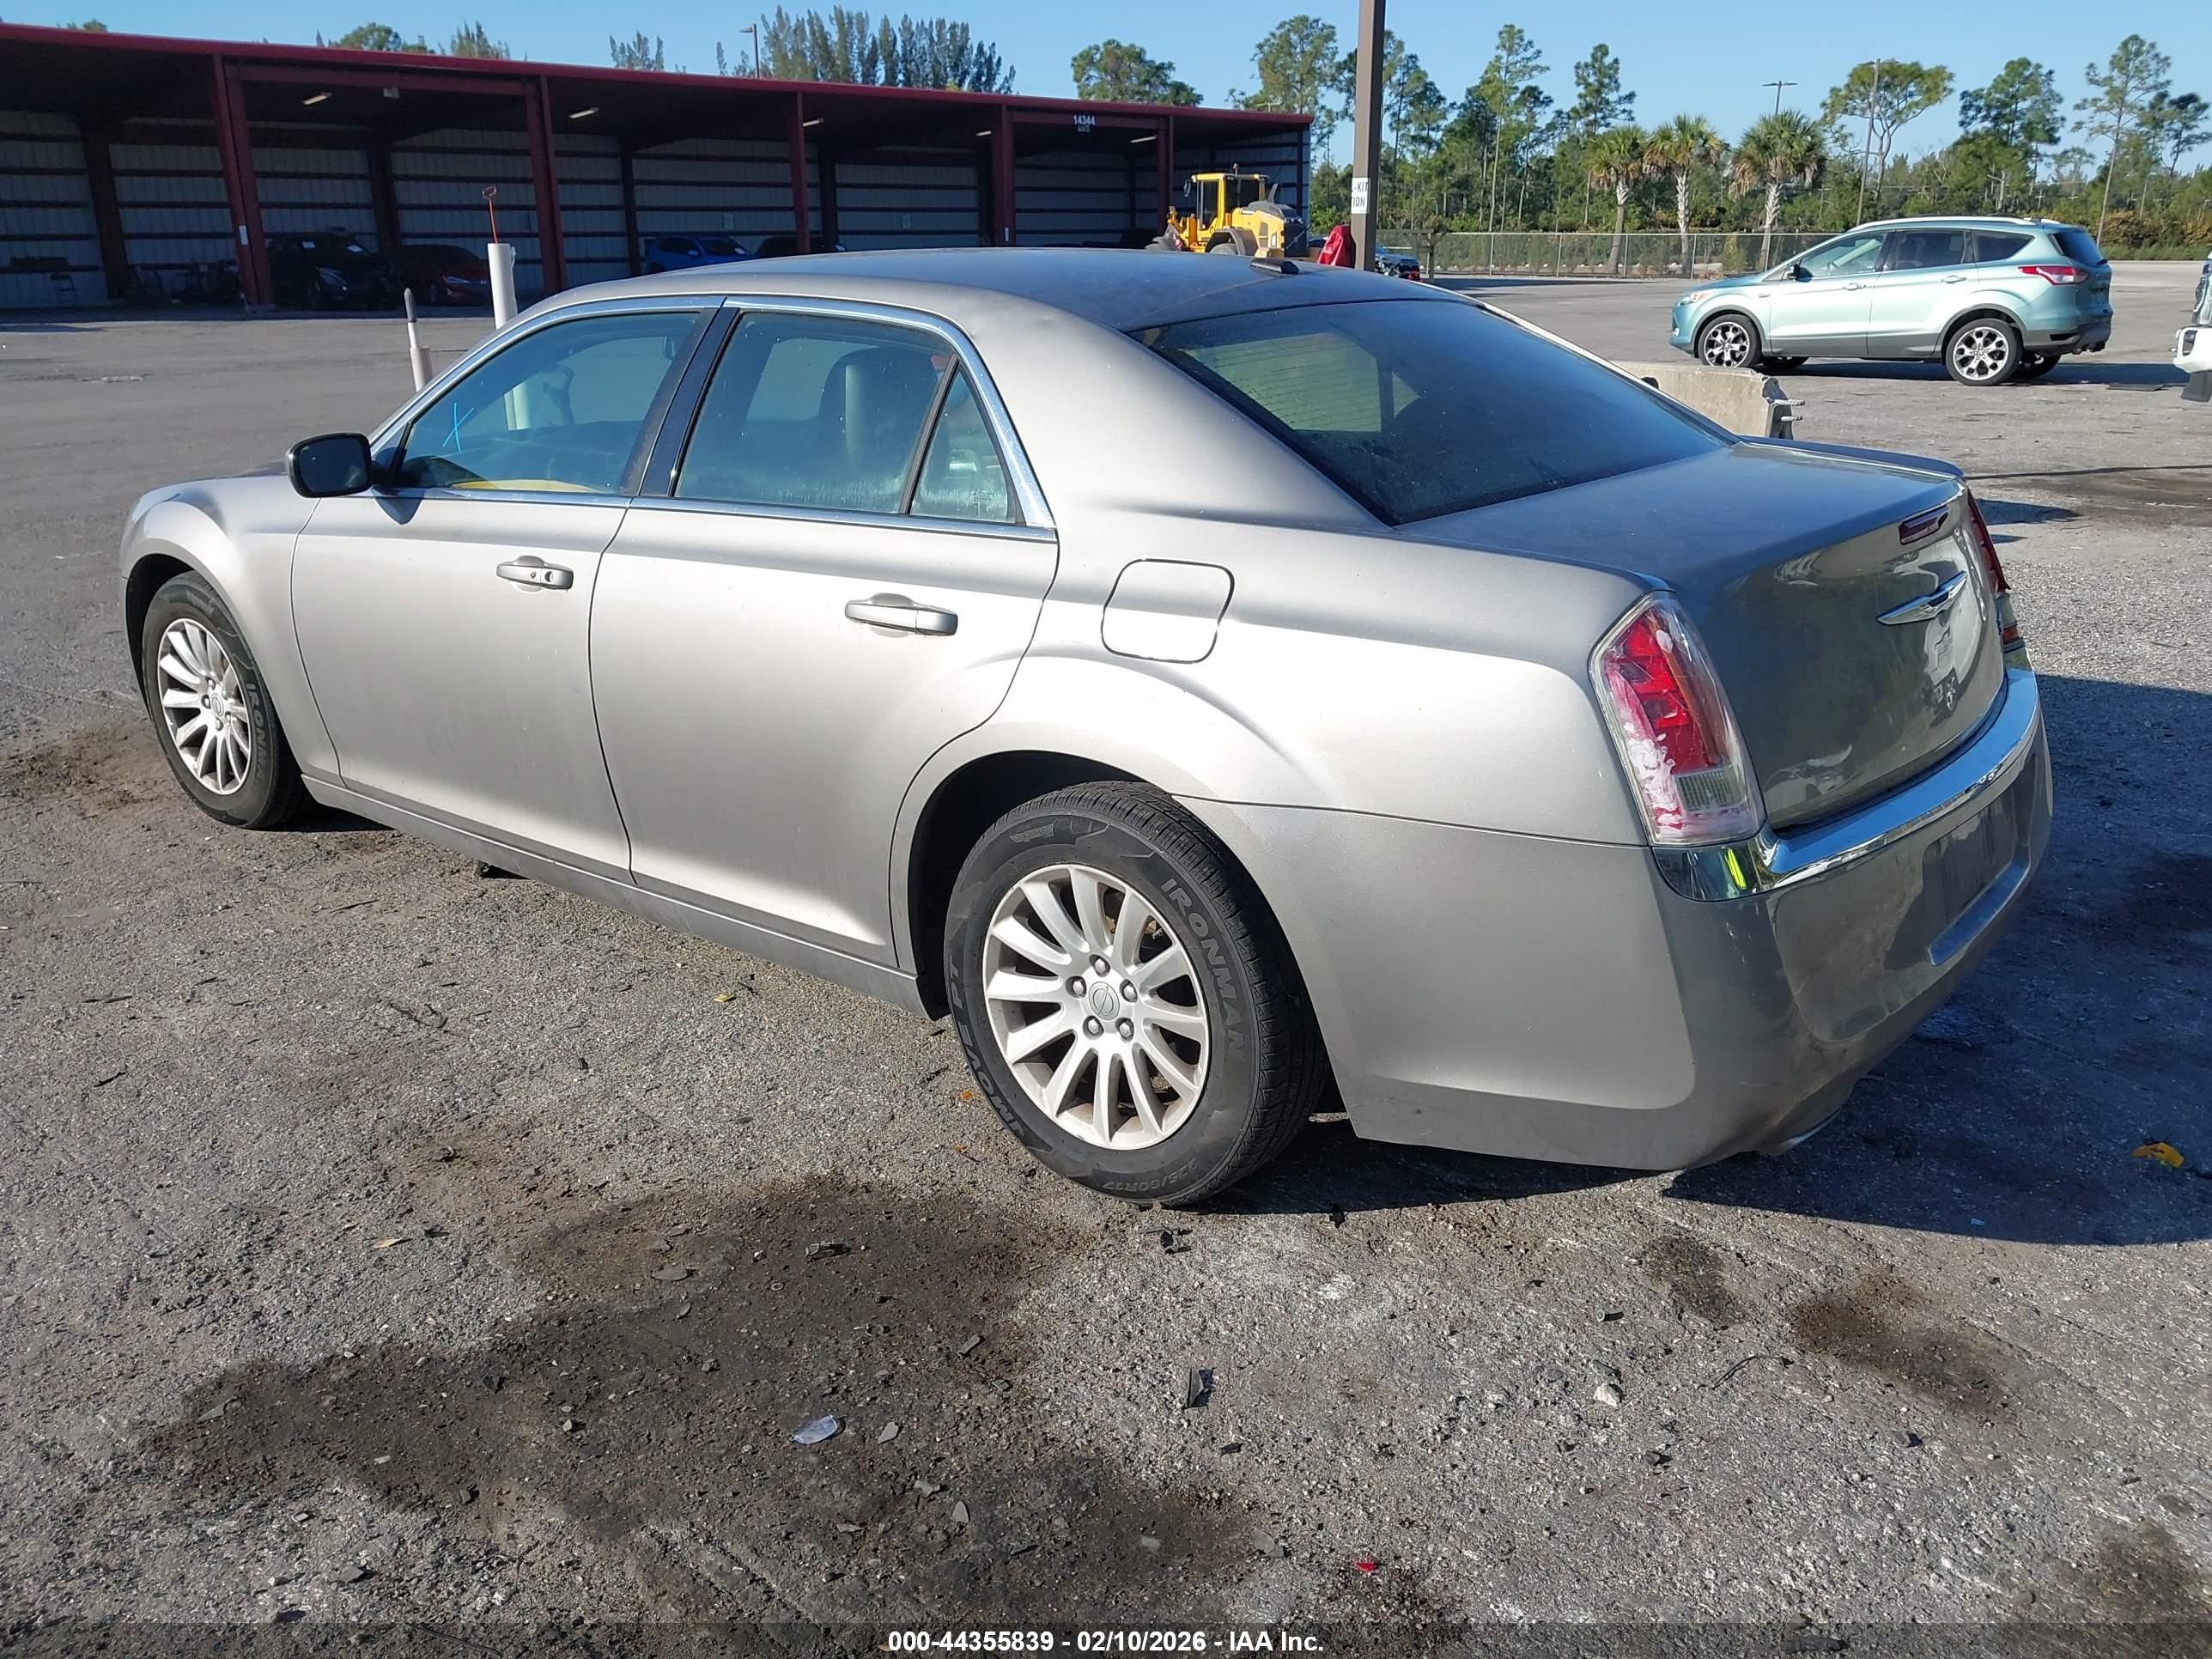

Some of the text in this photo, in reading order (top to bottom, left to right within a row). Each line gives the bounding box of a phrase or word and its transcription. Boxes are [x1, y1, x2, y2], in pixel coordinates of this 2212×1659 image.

[1073, 114, 1096, 125] 14344
[1352, 181, 1369, 193] -KIT
[949, 954, 963, 1010] PT
[1160, 878, 1245, 1054] IRONMAN
